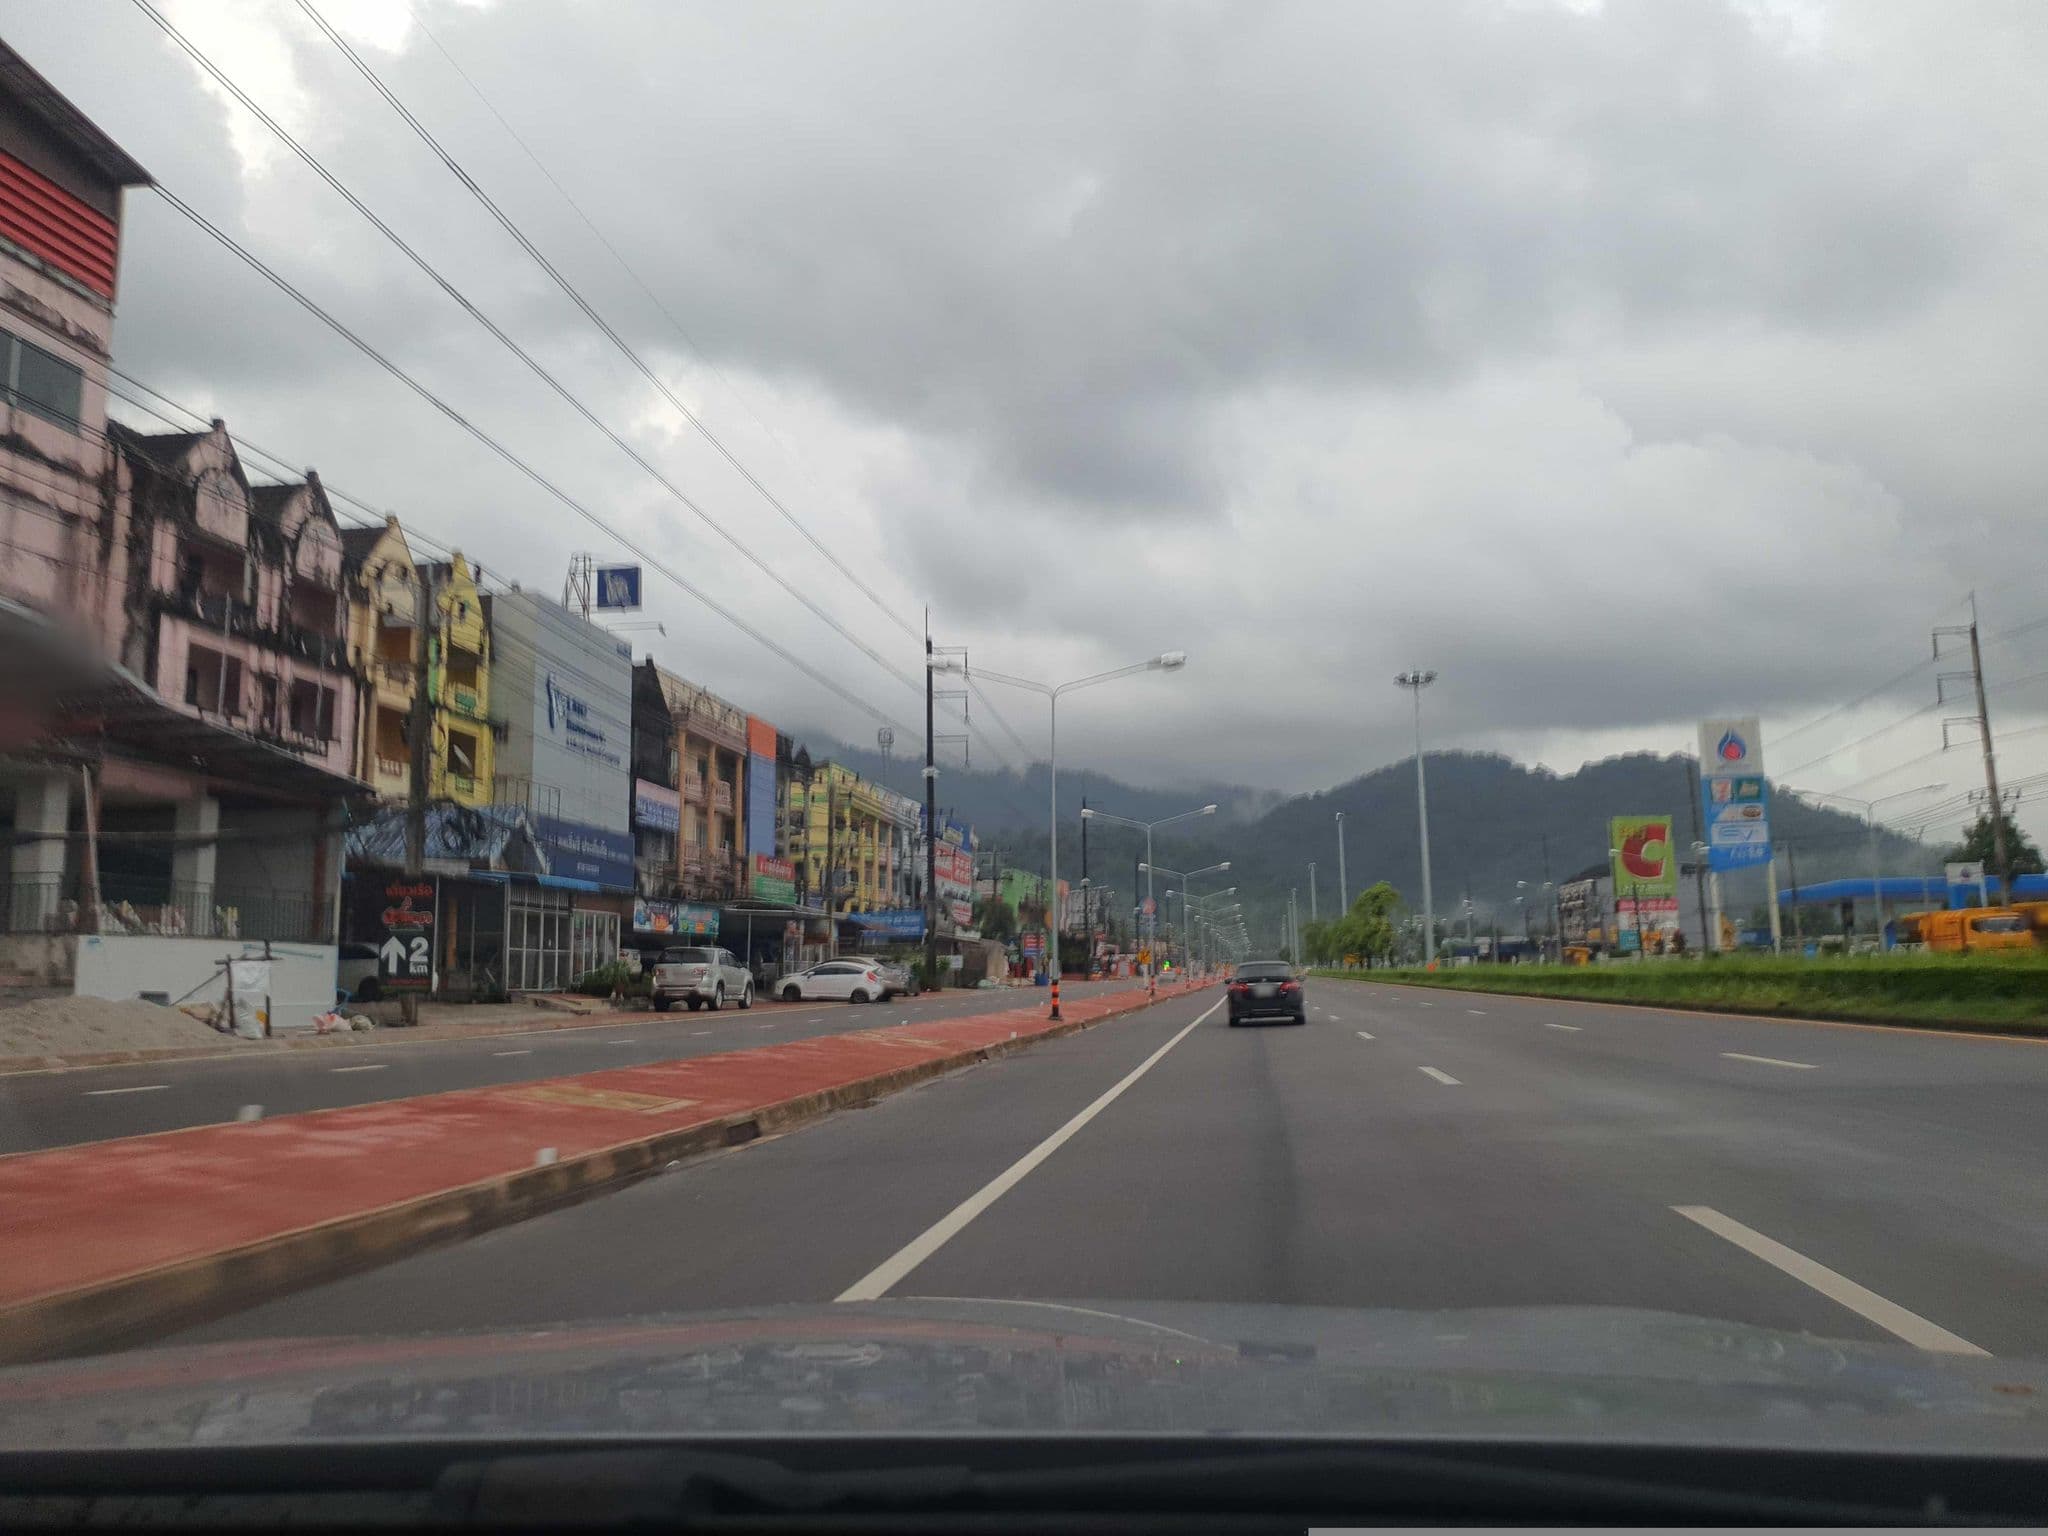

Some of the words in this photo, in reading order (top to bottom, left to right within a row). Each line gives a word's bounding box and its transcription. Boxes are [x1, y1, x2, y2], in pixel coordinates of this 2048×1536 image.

[1621, 823, 1670, 880] C
[409, 936, 428, 962] 2
[409, 964, 428, 976] km
